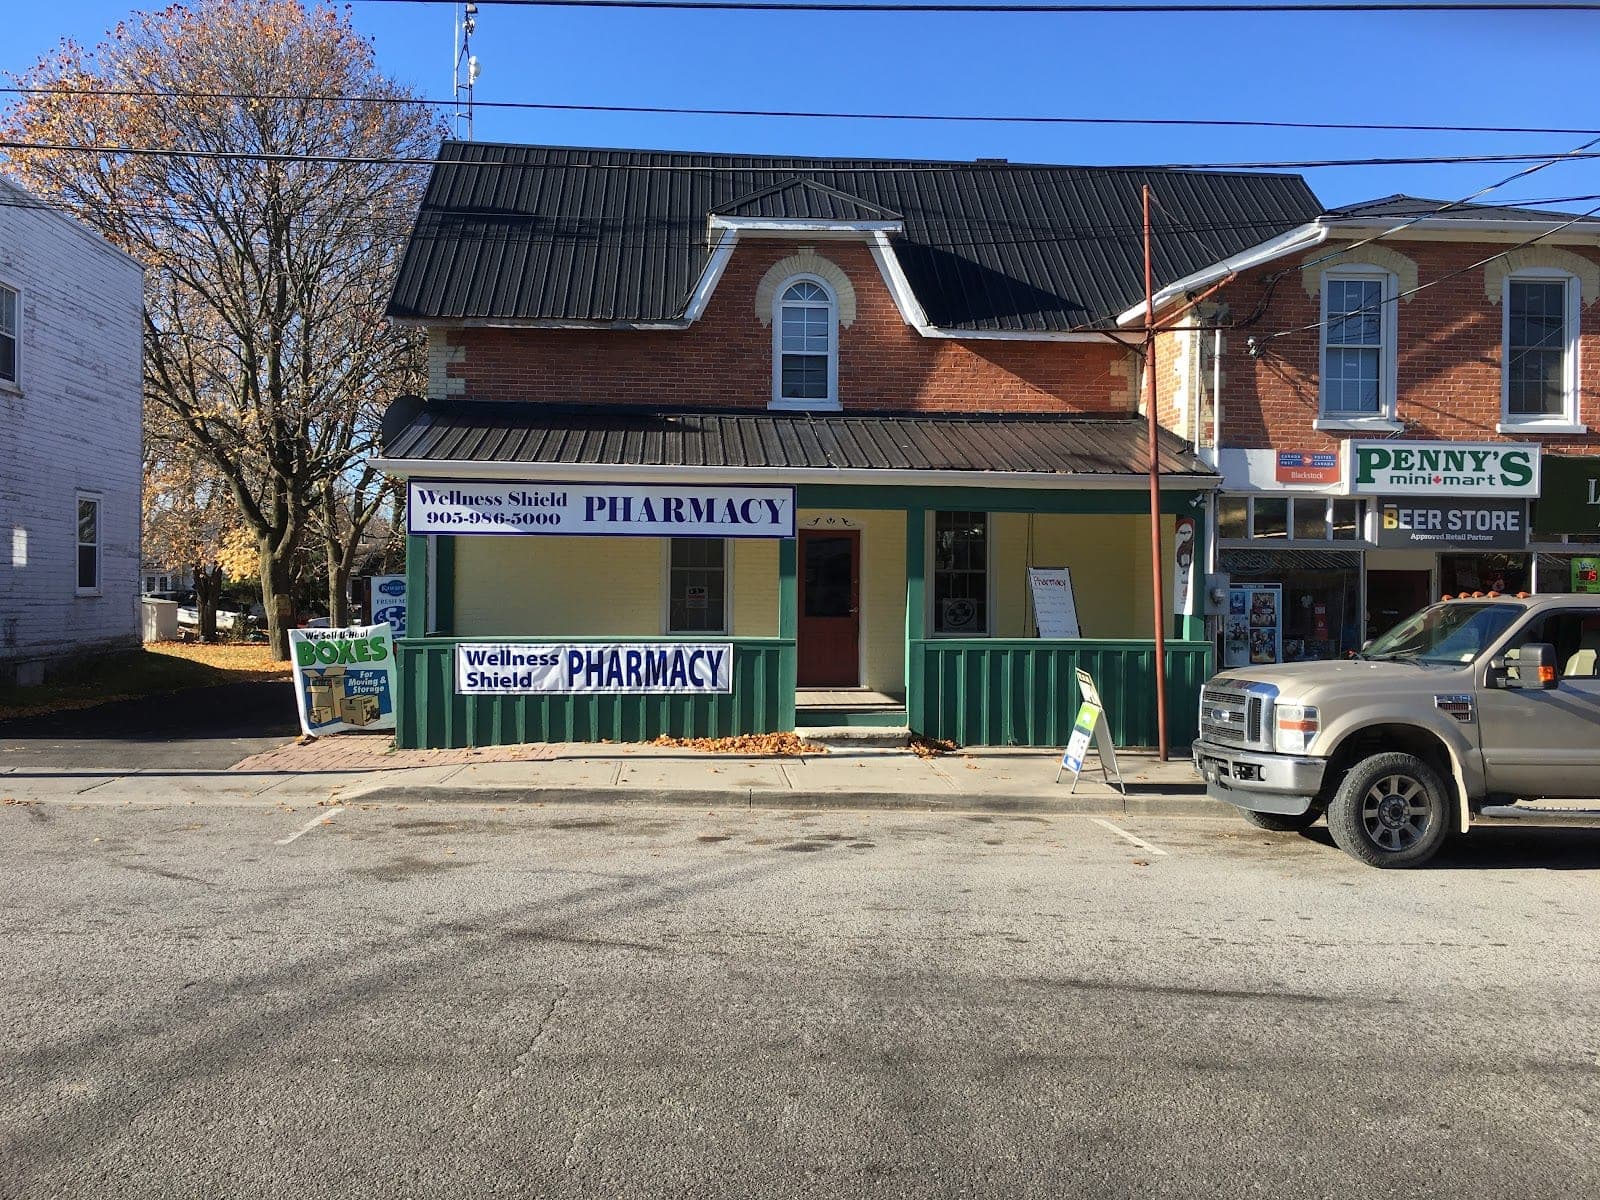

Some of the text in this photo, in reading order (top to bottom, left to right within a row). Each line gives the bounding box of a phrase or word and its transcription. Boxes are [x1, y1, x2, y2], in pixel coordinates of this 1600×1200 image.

[1290, 471, 1324, 479] Blackstock
[1355, 447, 1533, 487] PENNY'S
[1390, 473, 1496, 486] mini mart
[418, 489, 568, 507] Wellness Shield
[426, 511, 562, 525] 905-986-5000
[582, 496, 786, 524] PHARMACY
[1384, 506, 1520, 531] BEER STORE
[1410, 532, 1494, 541] Approved Retail Partner
[1033, 575, 1066, 591] Pharmacy
[305, 631, 319, 640] We
[321, 630, 338, 640] Sell
[295, 636, 388, 666] BOXES
[466, 650, 559, 666] Wellness
[360, 670, 374, 679] For
[568, 649, 723, 687] PHARMACY
[348, 676, 387, 688] Moving &
[466, 671, 533, 688] Shield
[352, 685, 385, 695] Storage
